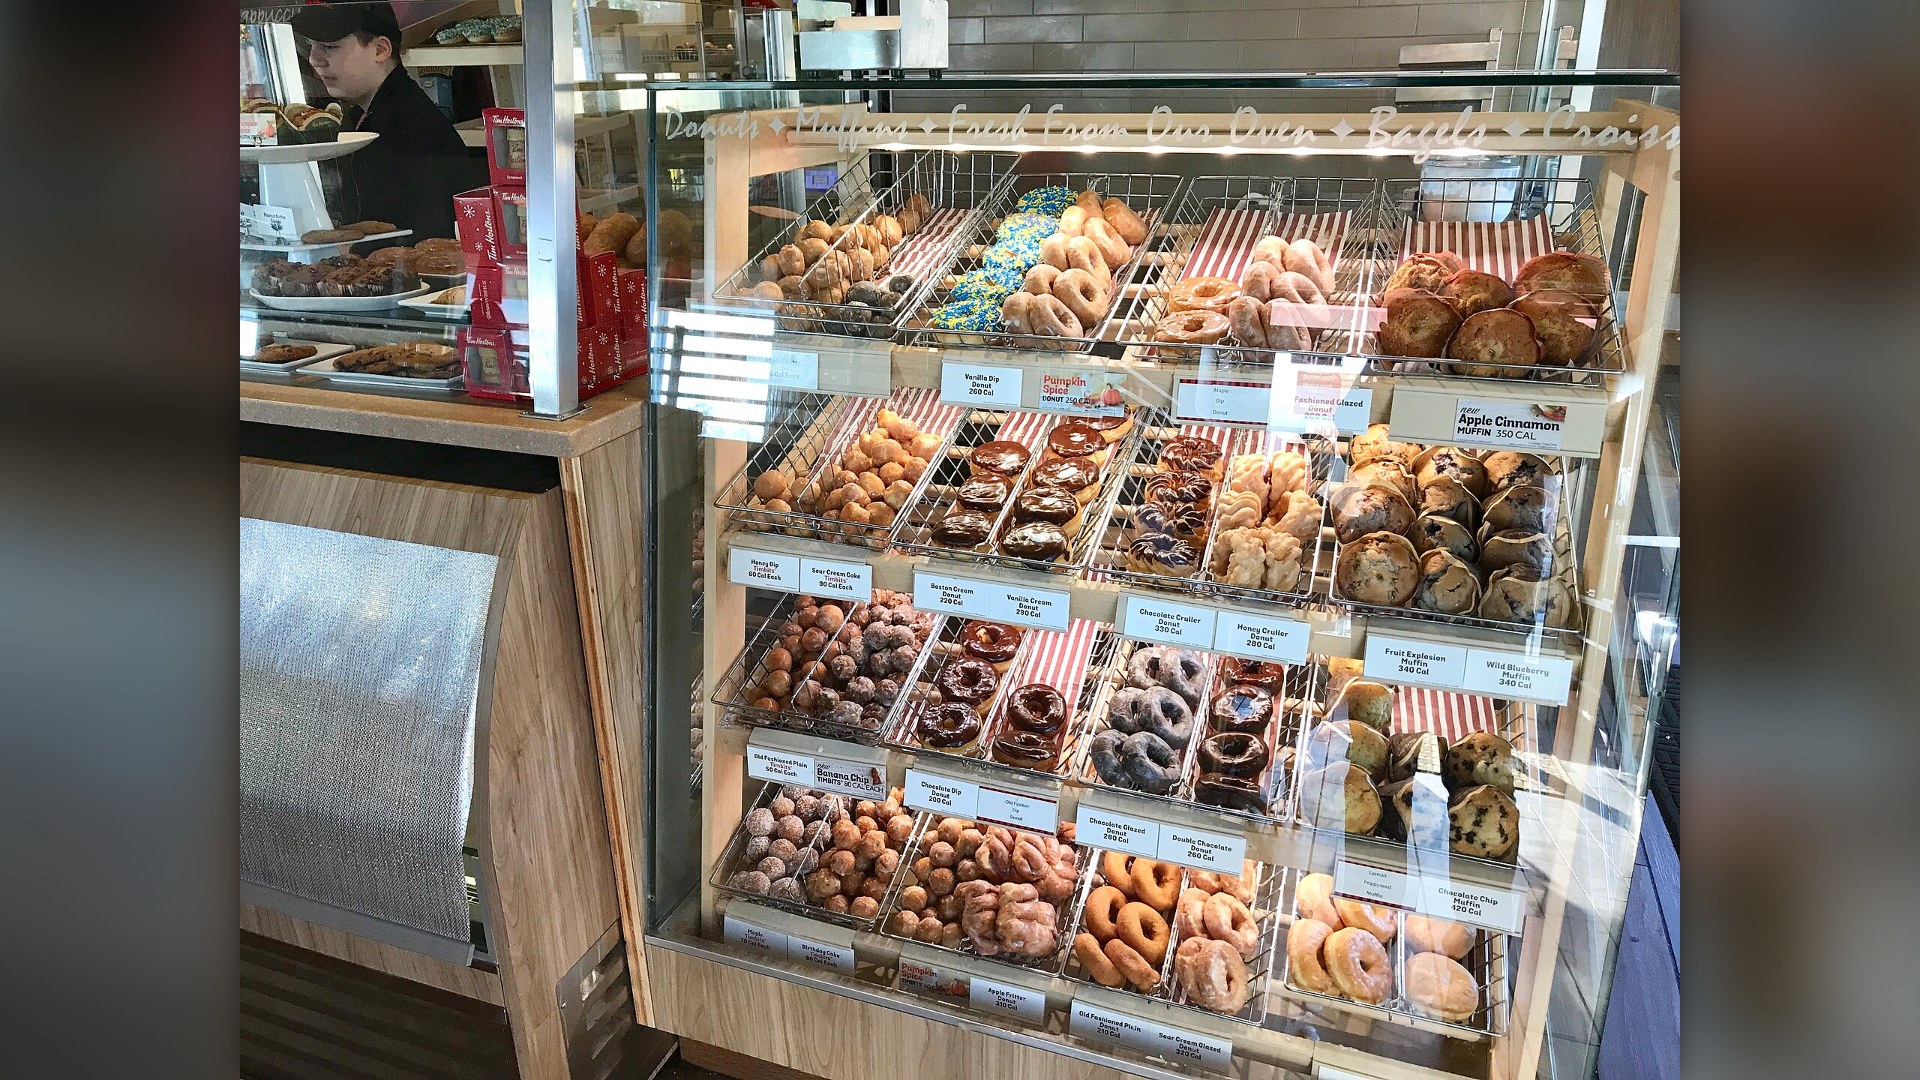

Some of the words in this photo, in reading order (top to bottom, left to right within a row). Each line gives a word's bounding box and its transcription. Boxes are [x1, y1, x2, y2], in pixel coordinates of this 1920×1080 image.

[492, 115, 503, 124] Tim
[665, 105, 760, 139] Donuts
[795, 103, 908, 152] Muffins
[948, 103, 1029, 151] Fresh
[1043, 103, 1130, 151] From
[1146, 105, 1213, 144] Our
[1229, 105, 1319, 146] Oven
[1364, 105, 1488, 164] Bagels
[501, 192, 511, 200] Tim
[484, 210, 495, 245] Hortons
[486, 245, 497, 260] Tim
[612, 263, 620, 299] Hortons
[614, 300, 622, 314] Tim
[467, 336, 476, 344] Tim
[475, 336, 496, 346] Hortons
[614, 333, 622, 364] Hortons
[587, 342, 596, 375] Hortons
[613, 365, 623, 381] Tim
[964, 373, 988, 382] Vanilla
[988, 375, 1000, 384] Dip
[587, 374, 597, 390] Tim
[971, 381, 992, 389] Donut
[1043, 374, 1087, 388] Pumpkin
[1042, 384, 1069, 395] Spice
[1213, 387, 1229, 395] Maple
[1042, 395, 1064, 404] DONUT
[1065, 396, 1078, 404] 250
[1294, 396, 1335, 406] Fashioned
[1336, 398, 1364, 408] Glazed
[1308, 405, 1333, 414] Donut
[1458, 413, 1493, 427] Apple
[1494, 415, 1560, 431] Cinnamon
[1457, 426, 1492, 437] MUFFIN
[1495, 429, 1514, 439] 350
[1515, 431, 1537, 441] CAL
[750, 559, 769, 567] Honey
[753, 565, 776, 573] Timbits
[766, 573, 782, 581] Each
[811, 567, 825, 575] Sour
[826, 569, 846, 577] Cream
[824, 576, 849, 584] Timbits
[838, 583, 853, 591] Each
[930, 583, 952, 591] Boston
[953, 586, 974, 595] Cream
[942, 591, 961, 600] Donut
[1006, 594, 1029, 603] Vanilla
[1030, 598, 1052, 607] Cream
[1018, 602, 1039, 611] Donut
[1030, 610, 1041, 618] Cal
[1139, 608, 1175, 620] Chocolate
[1176, 614, 1201, 624] Cruller
[1158, 618, 1181, 628] Donut
[1154, 625, 1170, 633] 330
[1170, 627, 1182, 635] Cal
[1237, 623, 1261, 635] Honey
[1261, 627, 1289, 637] Cruller
[1250, 632, 1274, 643] Donut
[1246, 639, 1262, 648] 280
[1262, 642, 1276, 650] Cal
[1384, 648, 1405, 657] Fruit
[1406, 650, 1446, 663] Explosion
[1401, 658, 1428, 668] Muffin
[1486, 660, 1506, 670] Wild
[1507, 663, 1550, 678] Blueberry
[1398, 665, 1414, 674] 340
[1416, 667, 1429, 675] Cal
[1502, 671, 1531, 682] Muffin
[1499, 678, 1516, 687] 340
[1517, 681, 1532, 689] Cal
[764, 755, 793, 765] Fashioned
[793, 760, 808, 769] Plain
[817, 767, 849, 781] Banana
[850, 773, 870, 785] Chip
[817, 776, 843, 786] TIMBITS
[852, 782, 865, 790] CAL
[865, 784, 884, 794] EACH
[920, 781, 951, 793] Chocolate
[951, 787, 962, 796] Dip
[931, 789, 950, 799] Donut
[928, 796, 941, 804] 200
[942, 798, 952, 806] Cal
[1010, 814, 1024, 822] Donut
[1089, 817, 1122, 829] Chocolate
[1122, 824, 1146, 835] Glazed
[1106, 827, 1127, 837] Donut
[1103, 833, 1117, 841] 280
[1118, 836, 1129, 844] Cal
[1172, 834, 1196, 845] Double
[1197, 839, 1233, 852] Chocolate
[1190, 844, 1212, 855] Donut
[1187, 850, 1202, 859] 260
[1202, 853, 1214, 862] Cal
[1365, 890, 1384, 899] Muffin
[1438, 887, 1479, 901] Chocolate
[1479, 895, 1499, 906] Chip
[1453, 897, 1481, 909] Muffin
[1450, 904, 1467, 913] 420
[1468, 908, 1482, 917] Cal
[801, 944, 826, 956] Birthday
[826, 950, 840, 958] Cake
[901, 962, 938, 978] Pumpkin
[901, 970, 923, 982] Spice
[988, 987, 1005, 997] Apple
[1005, 991, 1027, 1001] Fritter
[997, 995, 1017, 1005] Donut
[995, 1000, 1007, 1008] 310
[1079, 1010, 1090, 1018] Old
[1090, 1013, 1124, 1028] Fashioned
[1124, 1022, 1142, 1033] Plain
[1099, 1021, 1120, 1033] Donut
[1096, 1027, 1109, 1036] 210
[1109, 1031, 1121, 1039] Cal
[1158, 1032, 1175, 1042] Sour
[1175, 1036, 1198, 1047] Cream
[1198, 1042, 1222, 1053] Glazed
[1179, 1043, 1200, 1054] Donut
[1175, 1048, 1190, 1057] 320
[1190, 1052, 1202, 1061] Cal
